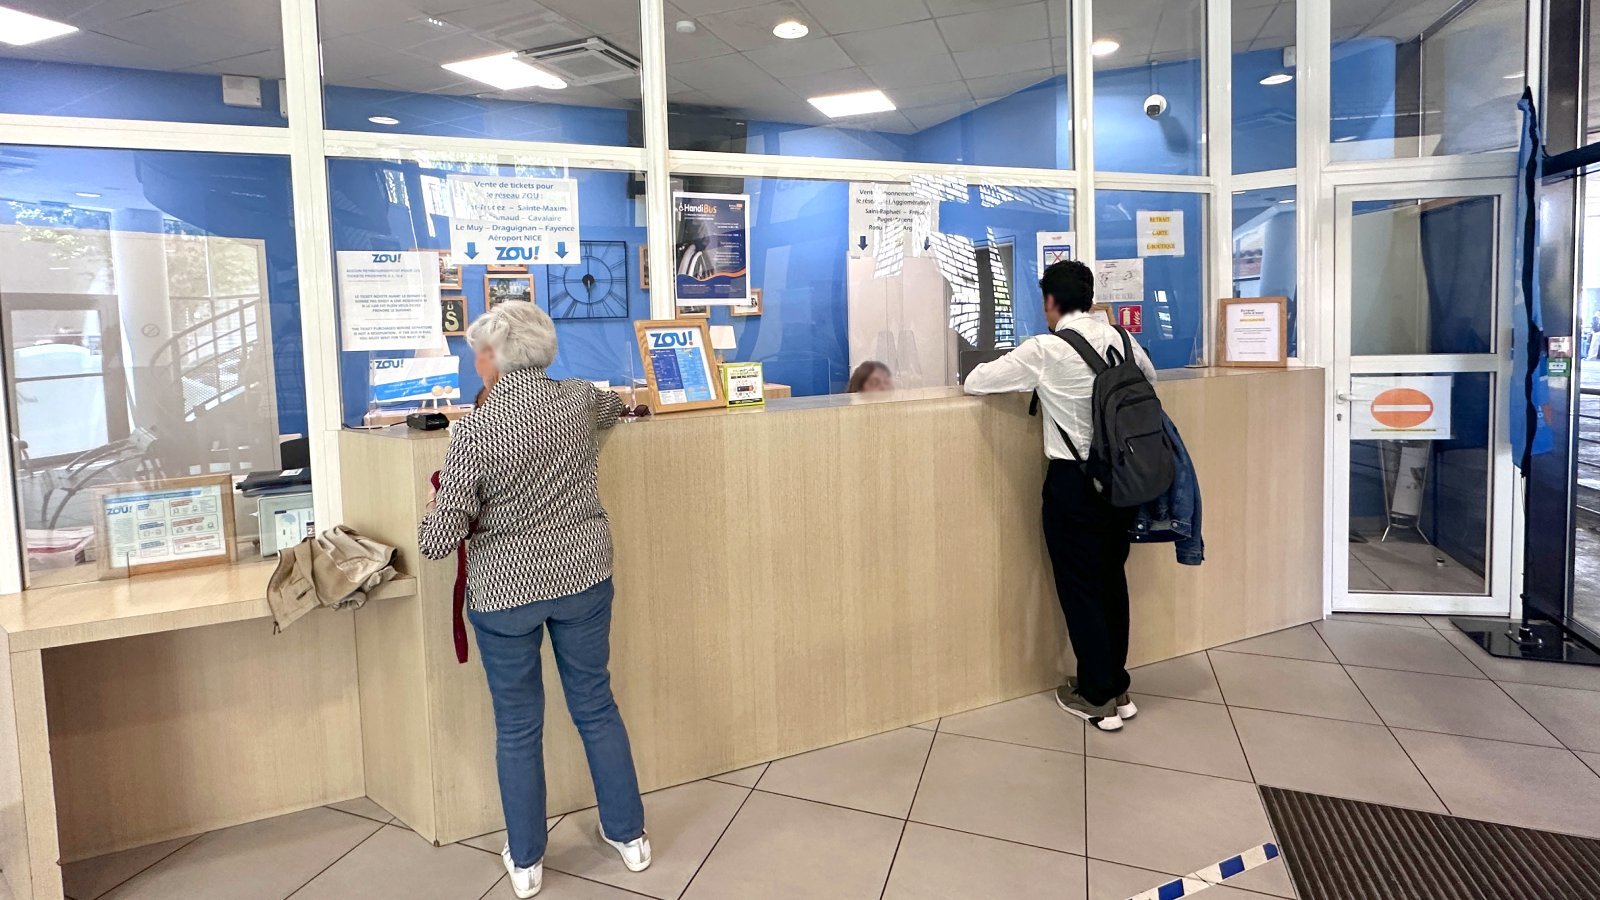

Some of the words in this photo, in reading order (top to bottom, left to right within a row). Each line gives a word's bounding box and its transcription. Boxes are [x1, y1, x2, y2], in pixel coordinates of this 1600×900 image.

[474, 181, 498, 189] Vente
[518, 204, 568, 212] Sainte-Maxim
[466, 225, 484, 233] Muy
[492, 224, 537, 233] Draguignan
[545, 225, 575, 233] Fayence
[488, 234, 522, 242] Aéroport
[495, 246, 540, 260] ZOU!
[372, 253, 402, 263] ZOU!
[650, 331, 694, 347] ZOU!
[374, 360, 404, 369] ZOU!
[106, 505, 133, 516] ZOU!
